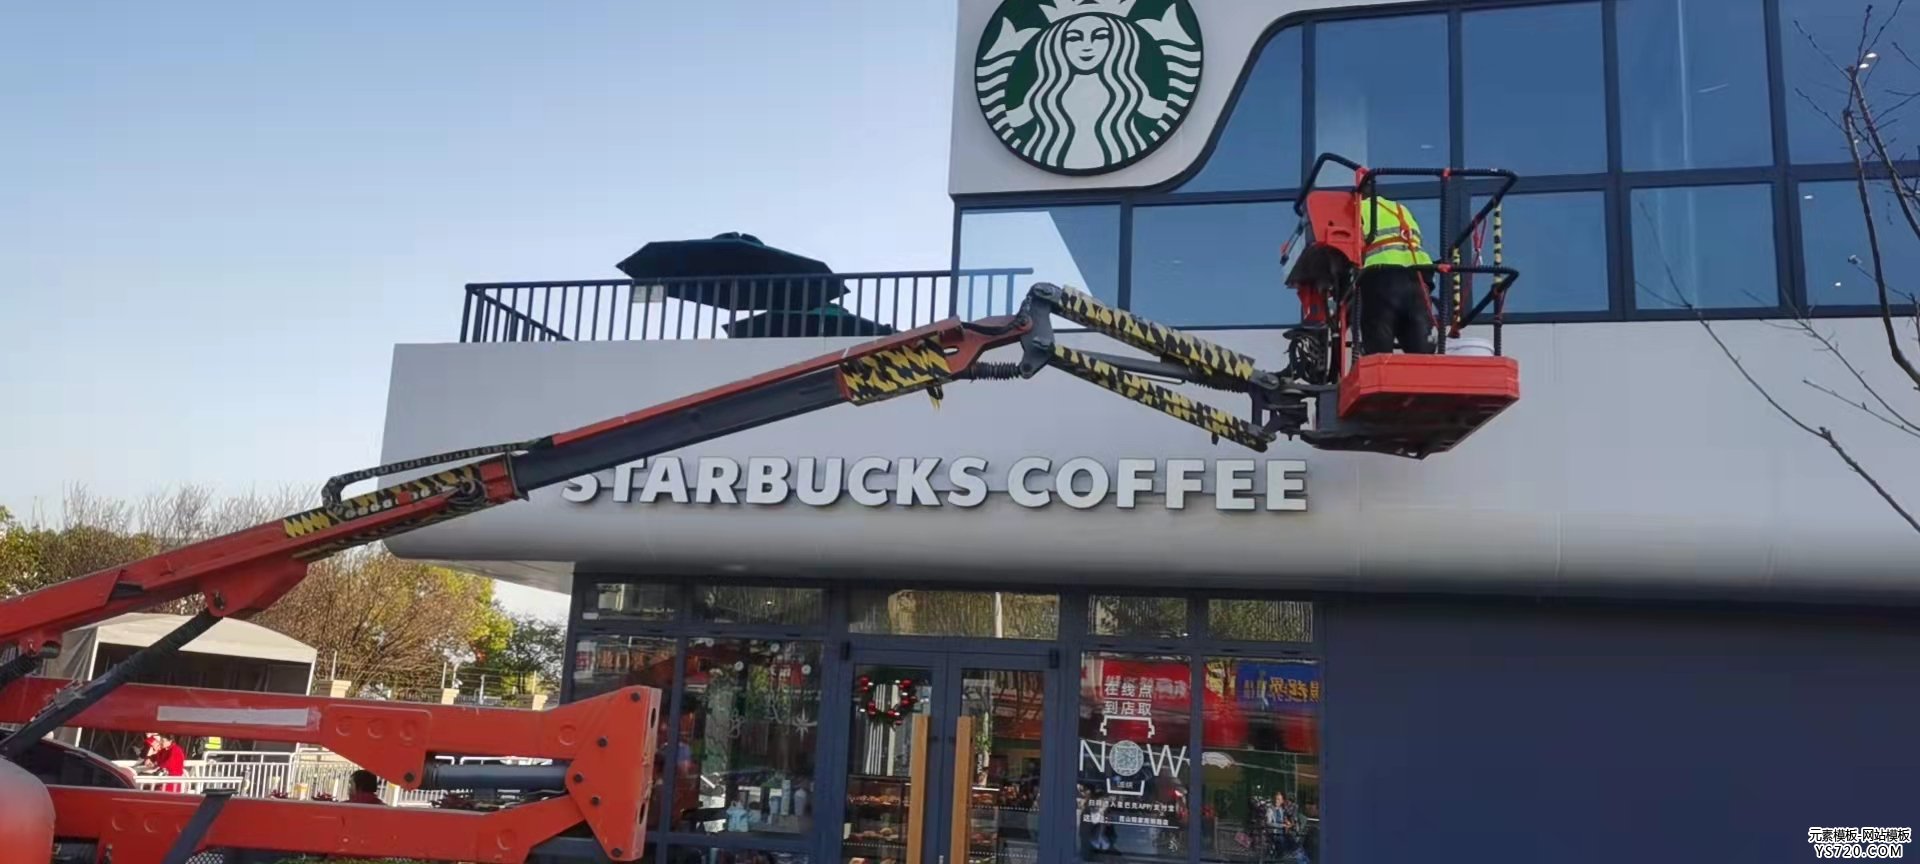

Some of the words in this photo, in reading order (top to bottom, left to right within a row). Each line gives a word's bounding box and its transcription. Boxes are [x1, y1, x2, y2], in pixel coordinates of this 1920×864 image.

[561, 457, 990, 509] STARBUCKS
[1007, 457, 1308, 511] COFFEE
[1104, 681, 1152, 698] 在线点
[1104, 701, 1152, 715] 到店取
